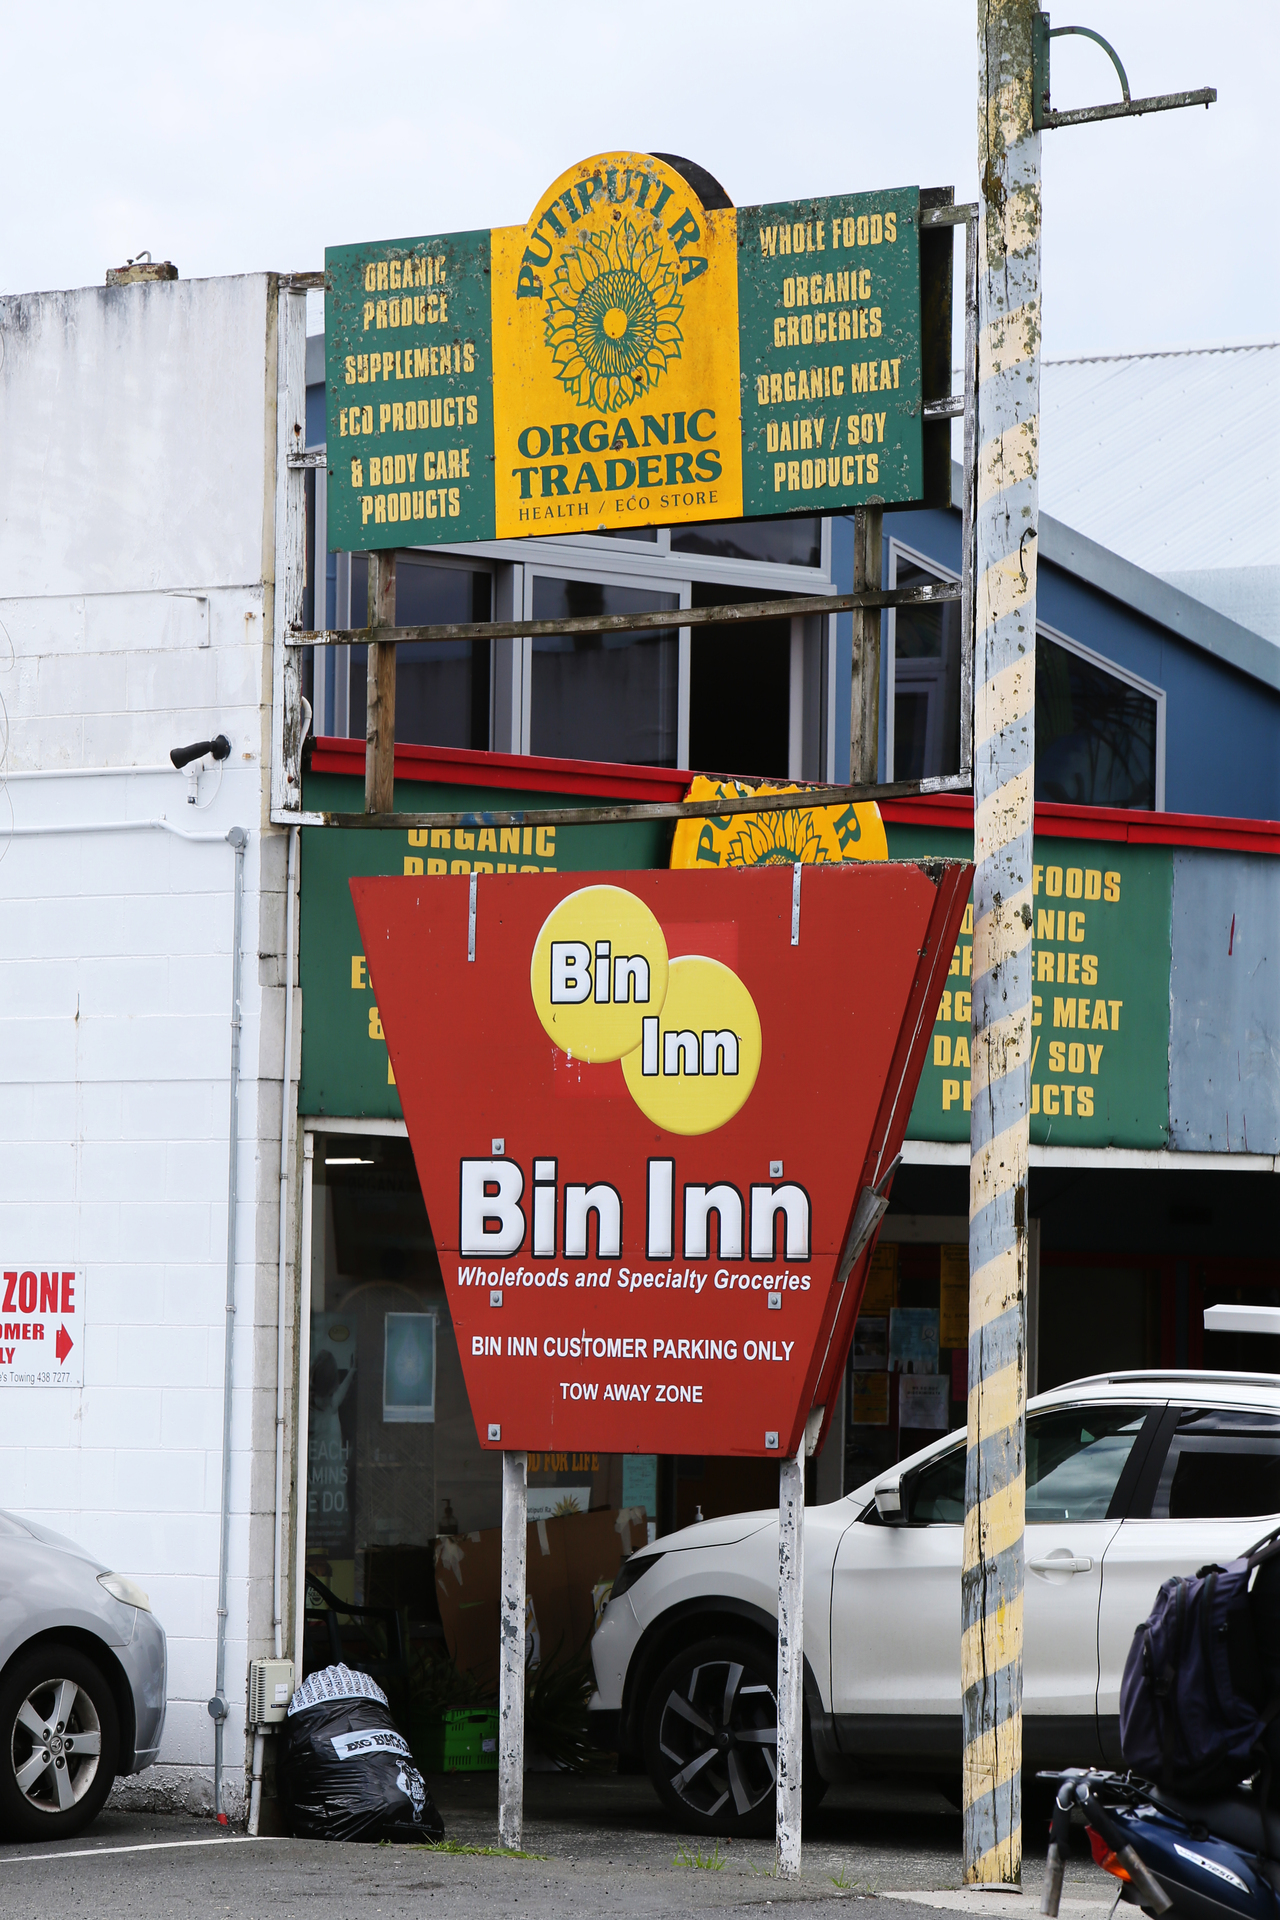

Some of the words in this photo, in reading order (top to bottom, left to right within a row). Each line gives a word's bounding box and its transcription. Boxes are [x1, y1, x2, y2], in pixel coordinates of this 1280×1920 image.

[517, 169, 675, 300] PUTIPUTI
[667, 207, 708, 286] RA
[759, 221, 825, 258] WHOLE
[833, 212, 897, 249] FOODS
[365, 255, 446, 292] ORGANIC
[783, 269, 872, 308] ORGANIC
[363, 292, 448, 331] PRODUCE
[774, 306, 882, 348] GROCERIES
[345, 343, 475, 385] SUPPLEMENTS
[757, 365, 844, 406] ORGANIC
[852, 358, 901, 394] MEAT
[339, 405, 373, 437] ECO
[380, 395, 478, 433] PRODUCTS
[517, 408, 717, 459] ORGANIC
[766, 417, 825, 453] DAIRY
[830, 416, 841, 451] /
[847, 412, 887, 446] SOY
[351, 459, 363, 488] &
[369, 452, 418, 487] BODY
[423, 448, 470, 482] CARE
[511, 449, 723, 499] TRADERS
[774, 453, 879, 492] PRODUCTS
[362, 488, 460, 525] PRODUCTS
[519, 502, 589, 521] HEALTH
[615, 497, 650, 512] ECO
[660, 490, 718, 508] STORE
[408, 826, 556, 857] ORGANIC
[1033, 864, 1121, 902] FOODS
[550, 940, 650, 1005] Bin
[1053, 997, 1123, 1031] MEAT
[641, 1016, 741, 1077] Inn
[1048, 1041, 1104, 1075] SOY
[459, 1156, 623, 1260] Bin
[645, 1156, 812, 1263] Inn
[2, 1271, 75, 1313] ZONE
[457, 1266, 569, 1289] Wholefoods
[574, 1267, 612, 1289] and
[617, 1267, 707, 1293] Specialty
[714, 1268, 812, 1291] Groceries
[471, 1336, 502, 1357] BIN
[507, 1337, 536, 1357] INN
[543, 1337, 648, 1359] CUSTOMER
[653, 1338, 738, 1360] PARKING
[743, 1340, 795, 1361] ONLY
[9, 1372, 35, 1385] Towing
[37, 1372, 50, 1383] 438
[560, 1382, 599, 1401] TOW
[603, 1383, 652, 1402] AWAY
[655, 1385, 704, 1403] ZONE
[544, 1454, 569, 1472] FOR
[572, 1454, 600, 1472] LIFE
[344, 1739, 372, 1752] BIG
